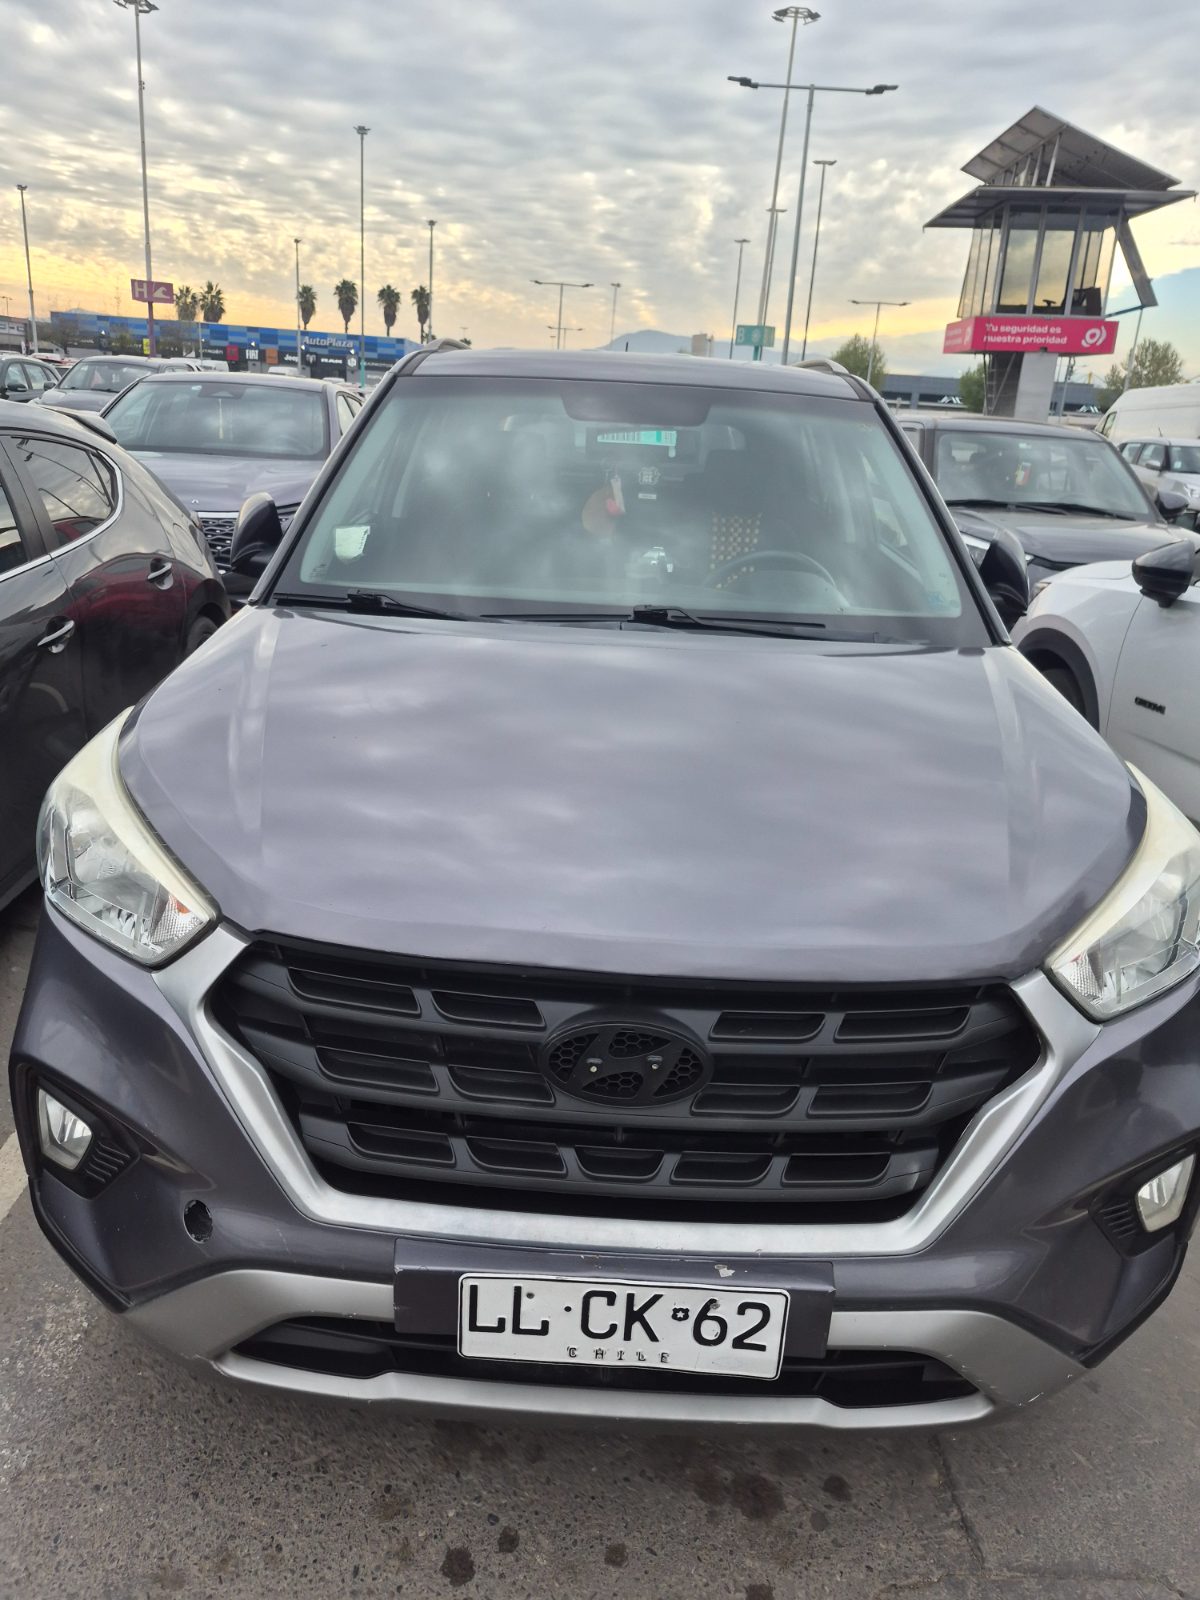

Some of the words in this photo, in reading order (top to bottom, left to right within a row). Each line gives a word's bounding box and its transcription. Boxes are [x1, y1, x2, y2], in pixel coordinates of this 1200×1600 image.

[134, 281, 148, 299] H
[985, 323, 998, 332] Tu
[1000, 324, 1048, 334] seguridad
[1049, 326, 1062, 334] es
[303, 336, 353, 348] AutoPlaza
[983, 335, 1021, 344] nuestra
[1023, 335, 1068, 345] prioridad
[245, 349, 259, 360] FIAT
[566, 1346, 670, 1364] CHILE
